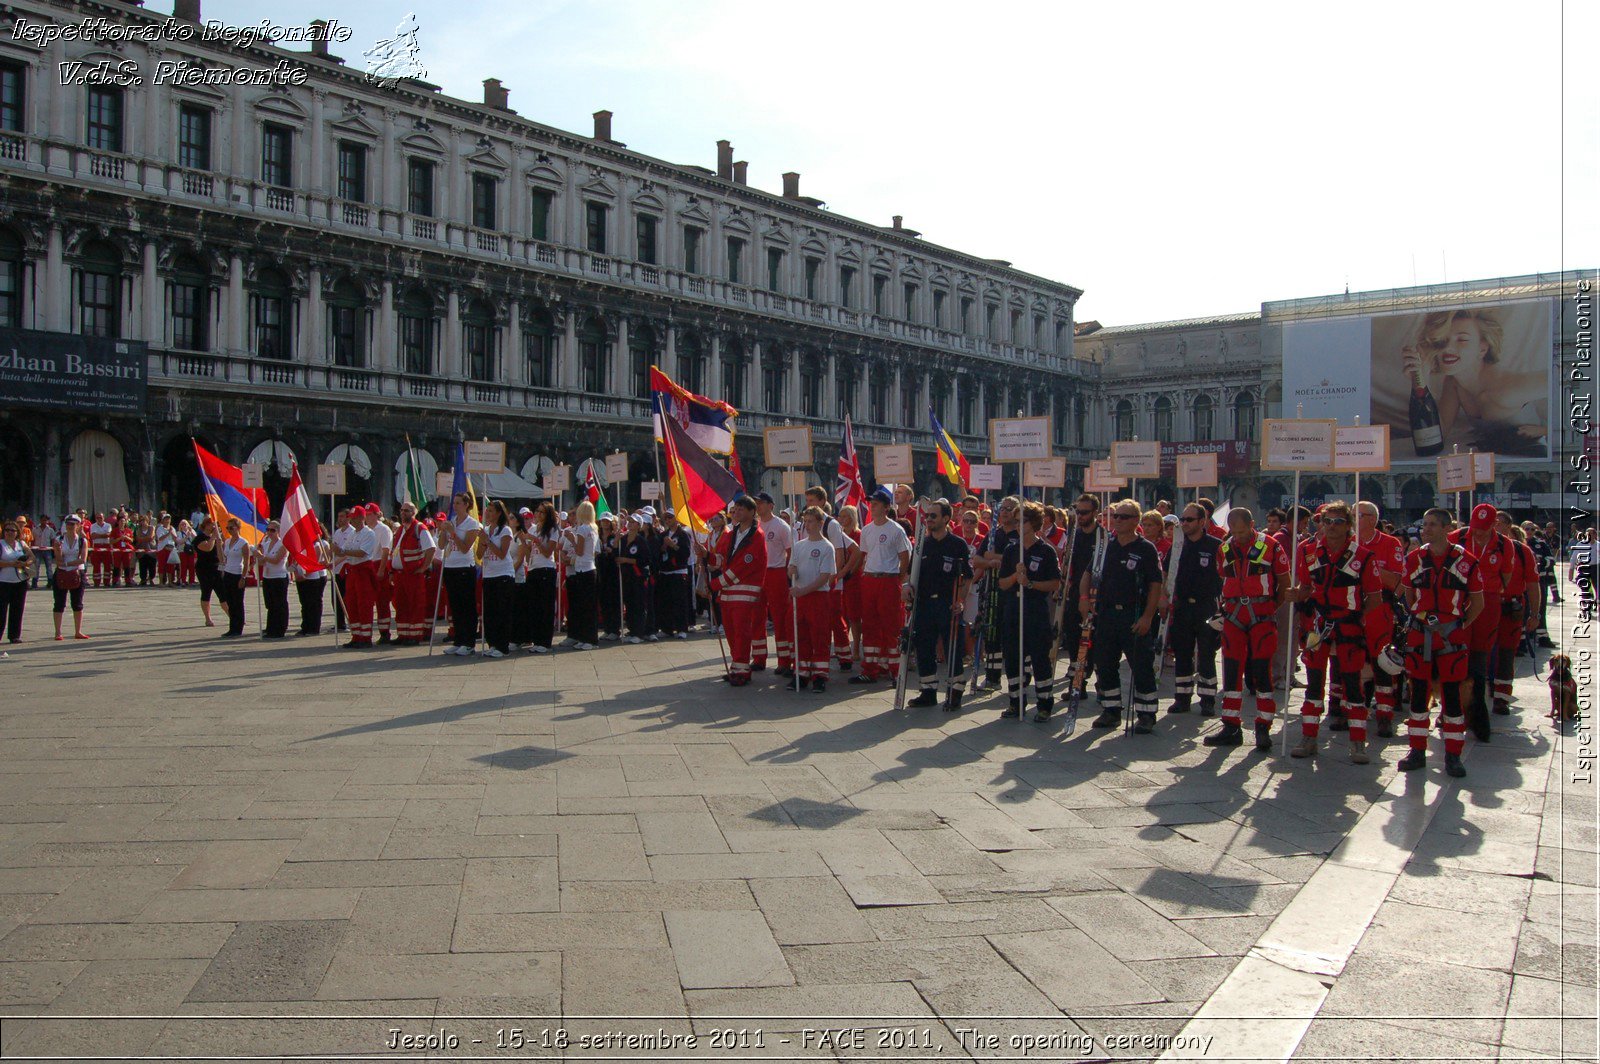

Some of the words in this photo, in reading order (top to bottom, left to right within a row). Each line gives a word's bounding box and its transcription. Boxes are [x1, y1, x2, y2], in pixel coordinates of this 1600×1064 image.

[65, 353, 141, 379] Bassiri
[1321, 386, 1357, 395] CHANDON
[1178, 443, 1226, 454] Schnabel
